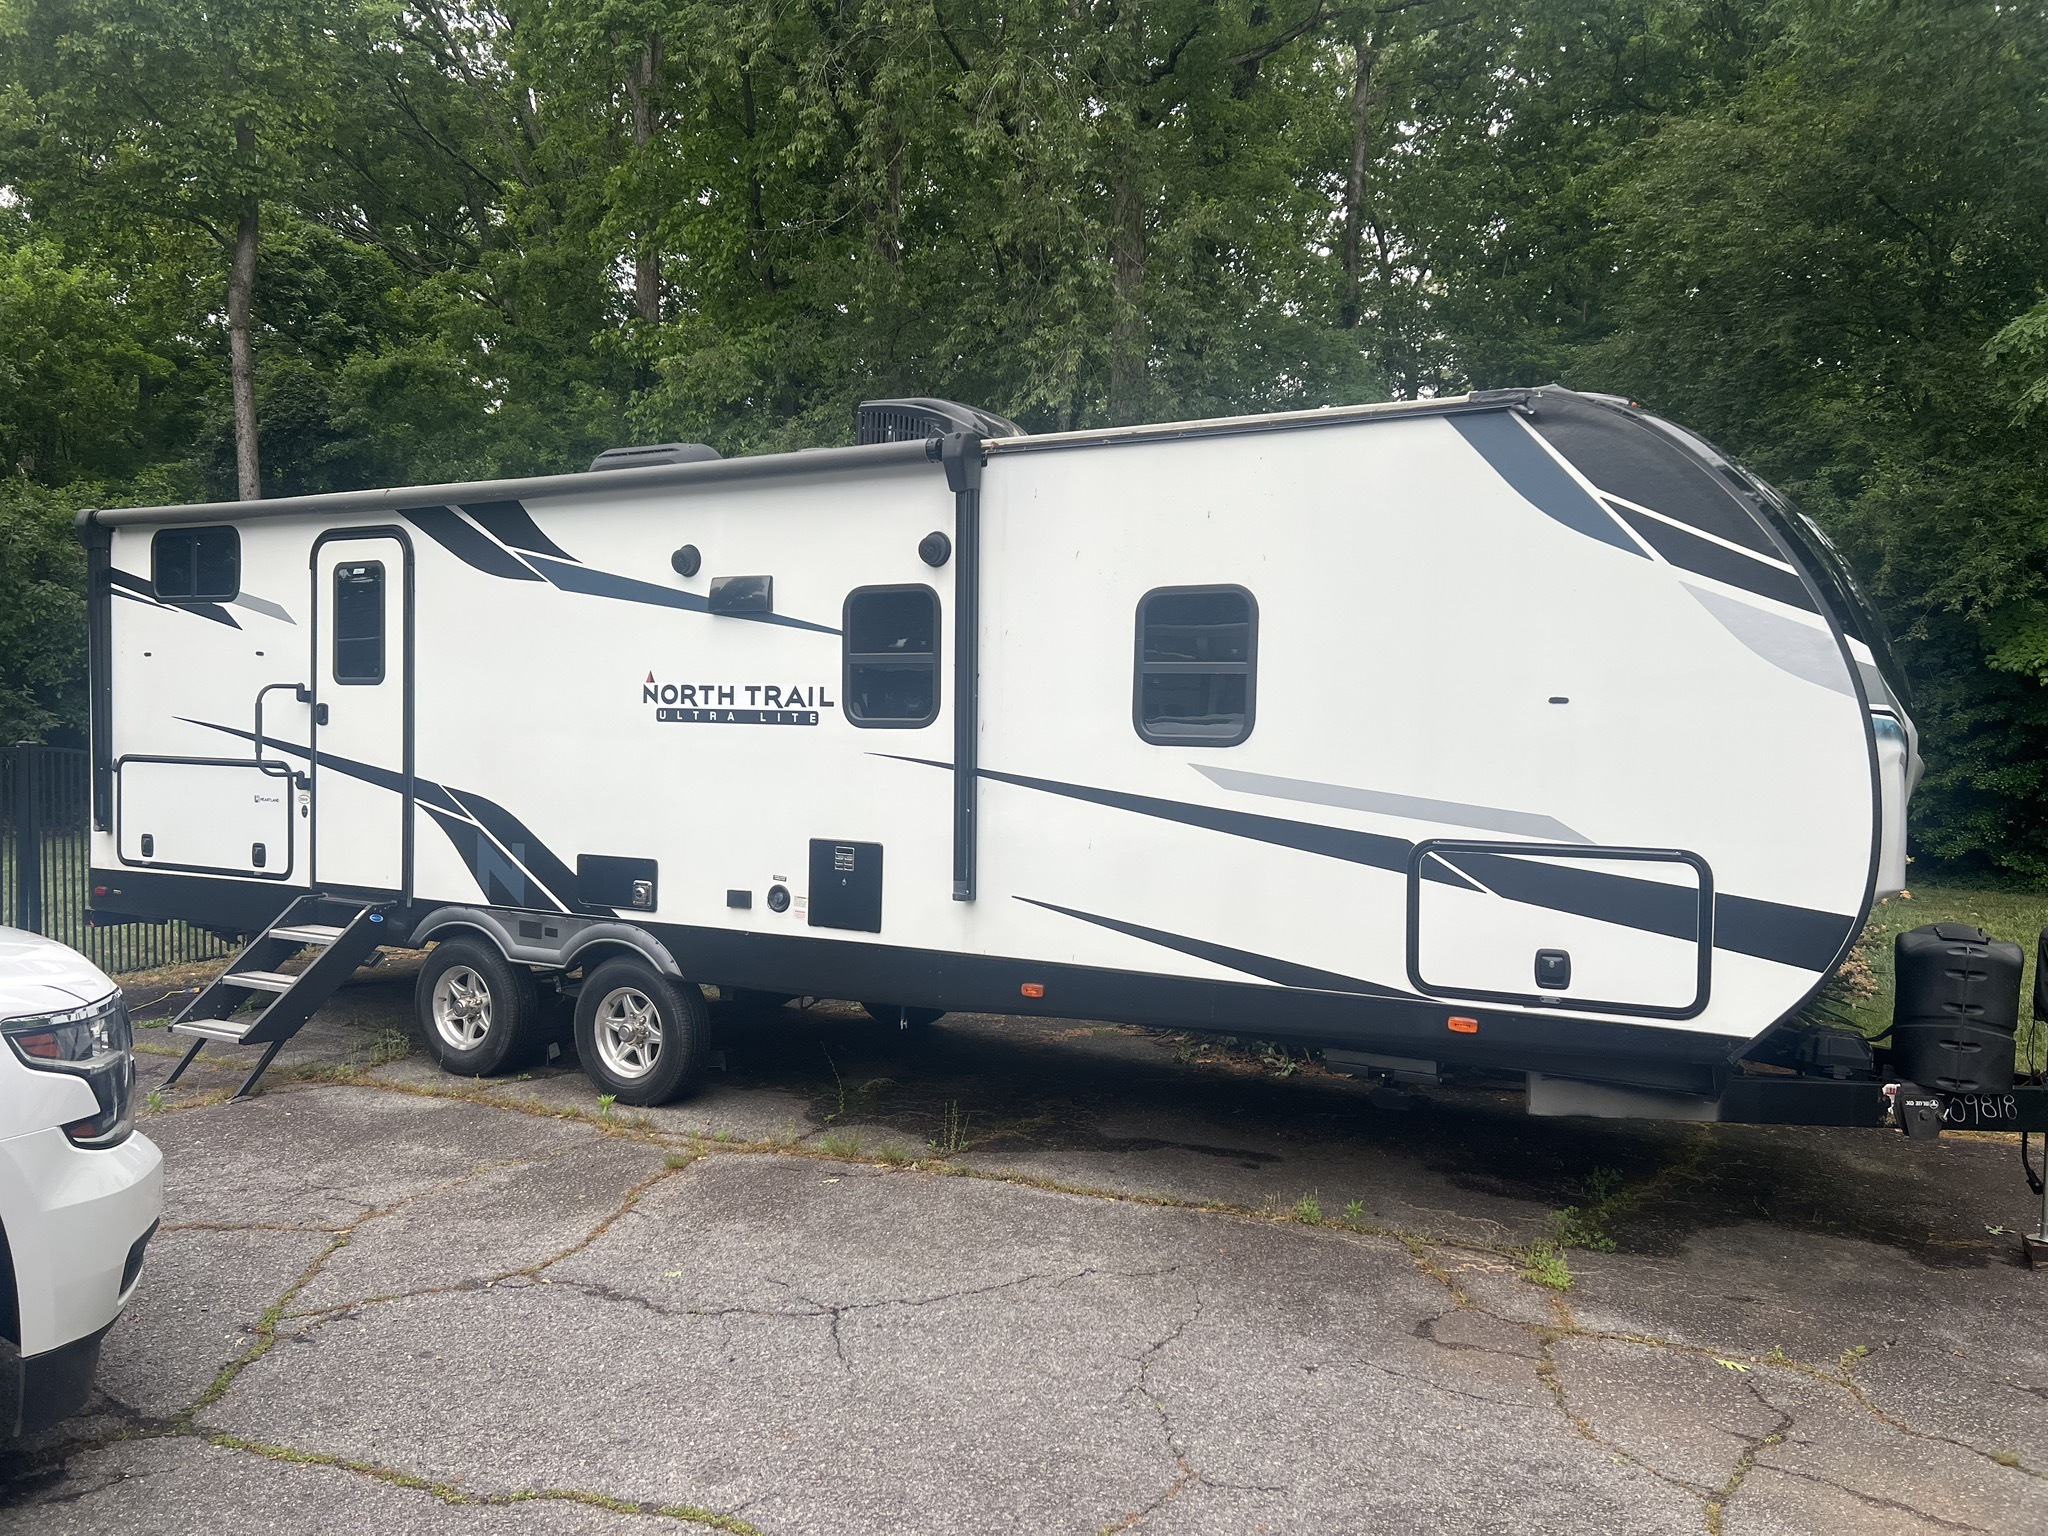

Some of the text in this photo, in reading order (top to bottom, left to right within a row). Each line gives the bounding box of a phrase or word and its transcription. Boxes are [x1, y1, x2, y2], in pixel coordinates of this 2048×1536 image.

[643, 683, 835, 709] NORTH TRAIL
[659, 710, 817, 723] ULTRA LITE
[1943, 1094, 2018, 1125] 09818
